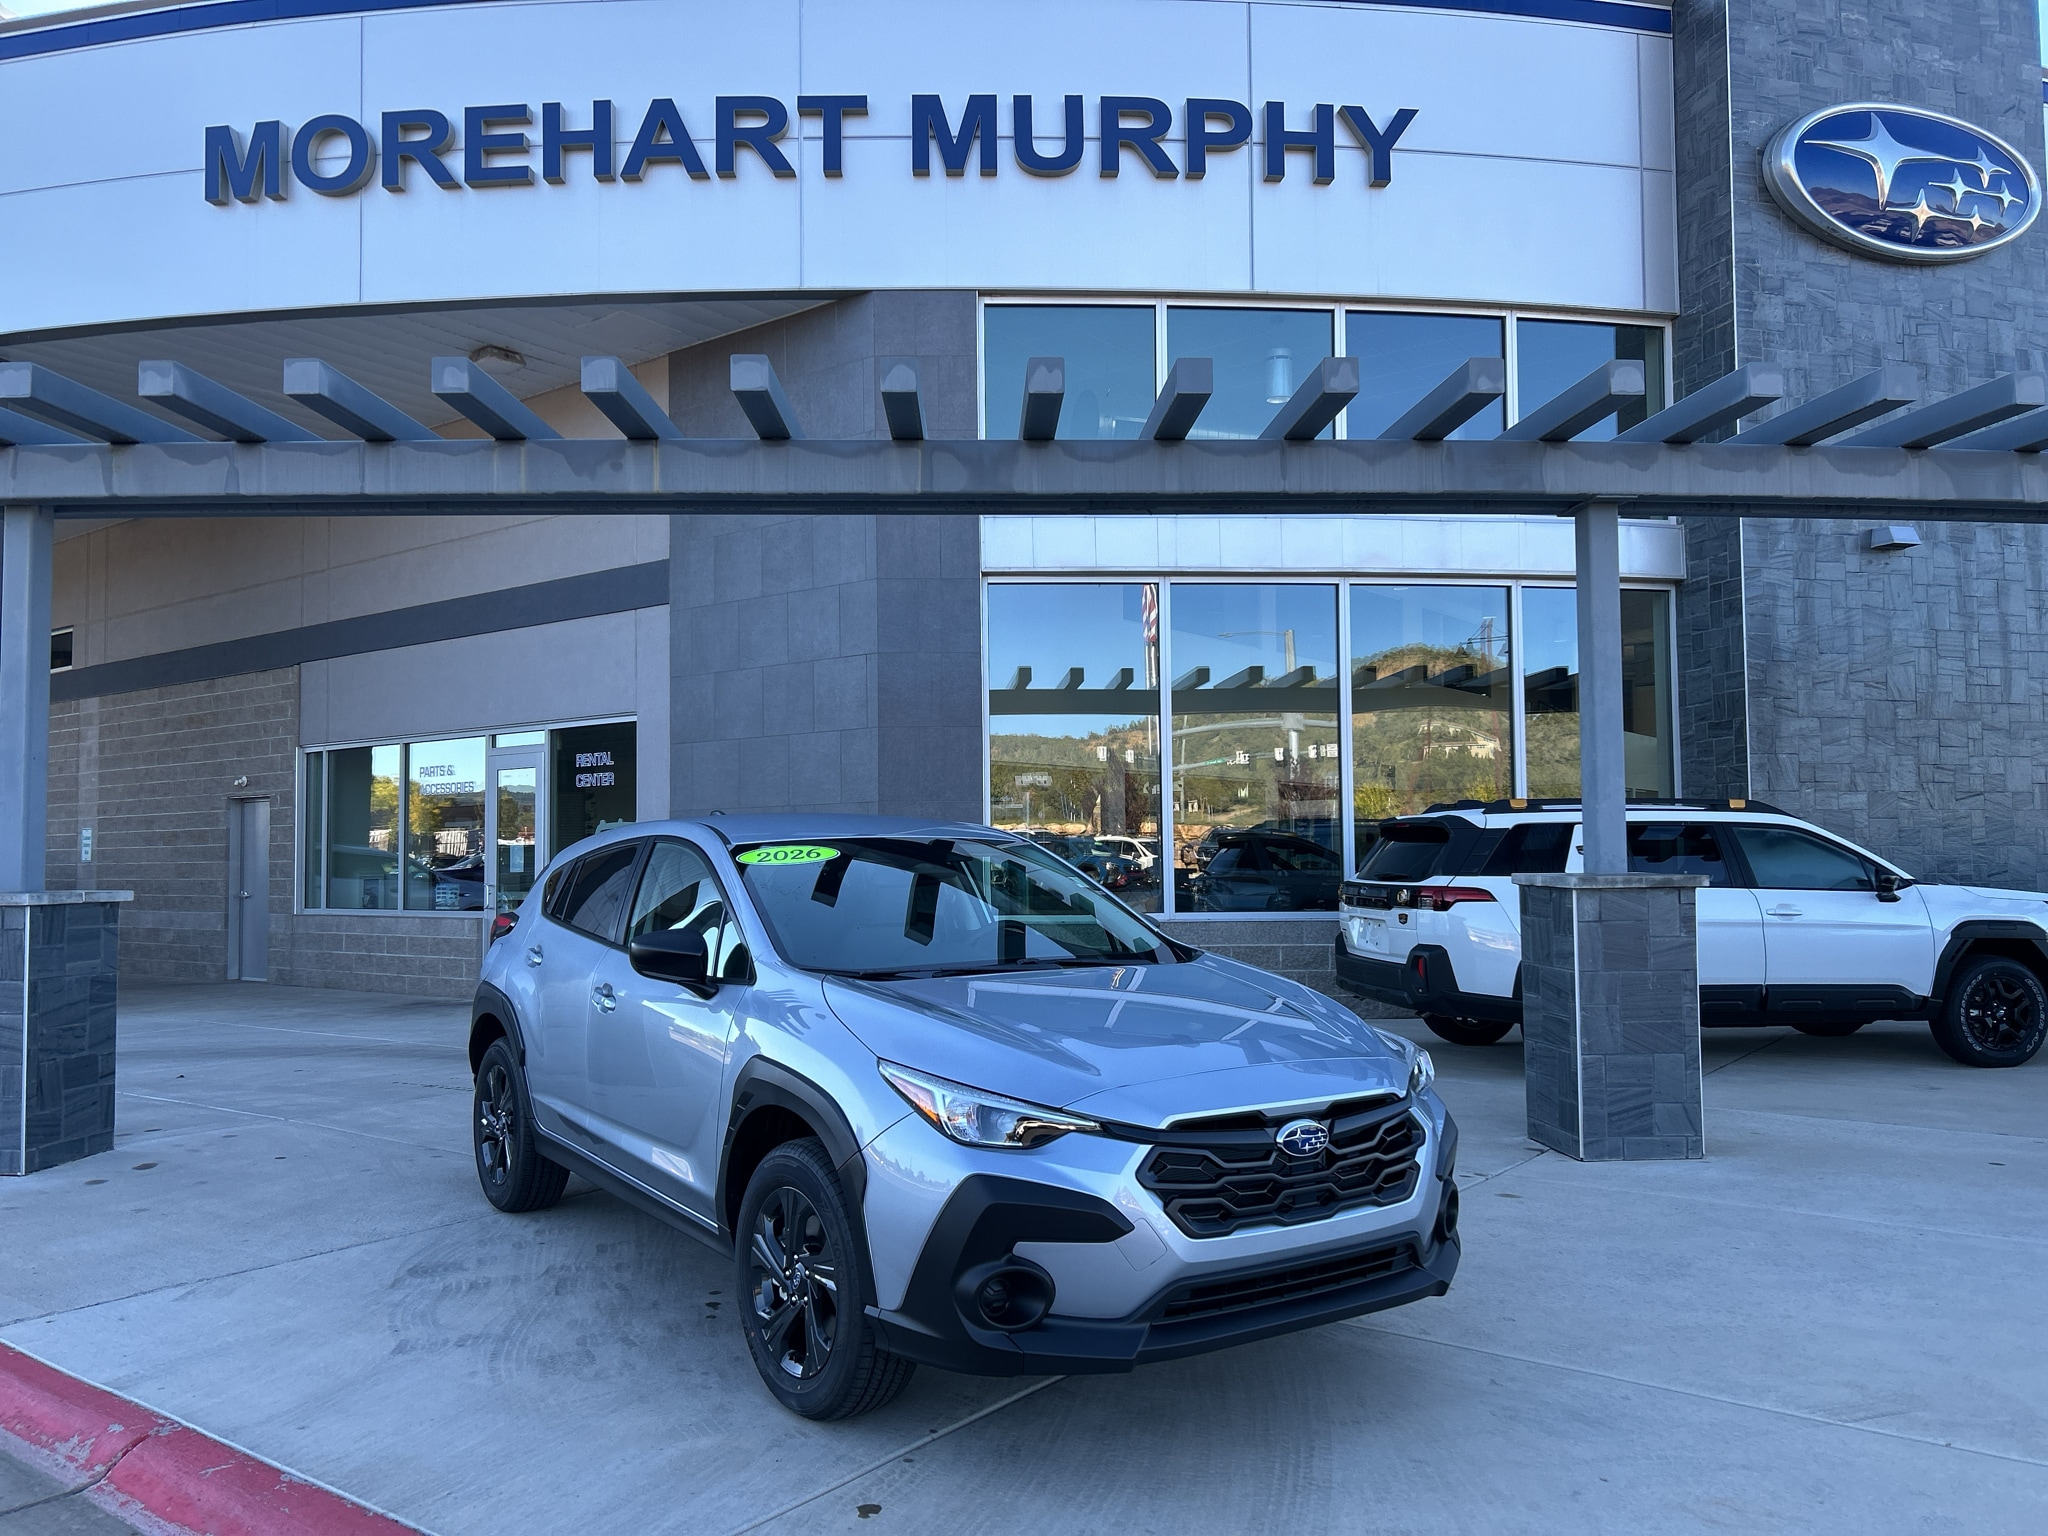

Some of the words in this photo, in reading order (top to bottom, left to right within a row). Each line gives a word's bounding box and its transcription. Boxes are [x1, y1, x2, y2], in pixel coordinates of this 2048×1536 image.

[204, 94, 868, 206] MOREHART
[910, 94, 1420, 188] MURPHY
[575, 751, 615, 768] RENTAL
[419, 765, 445, 778] PARTS
[446, 764, 455, 776] &
[575, 772, 615, 788] CENTER
[756, 848, 821, 863] 2026
